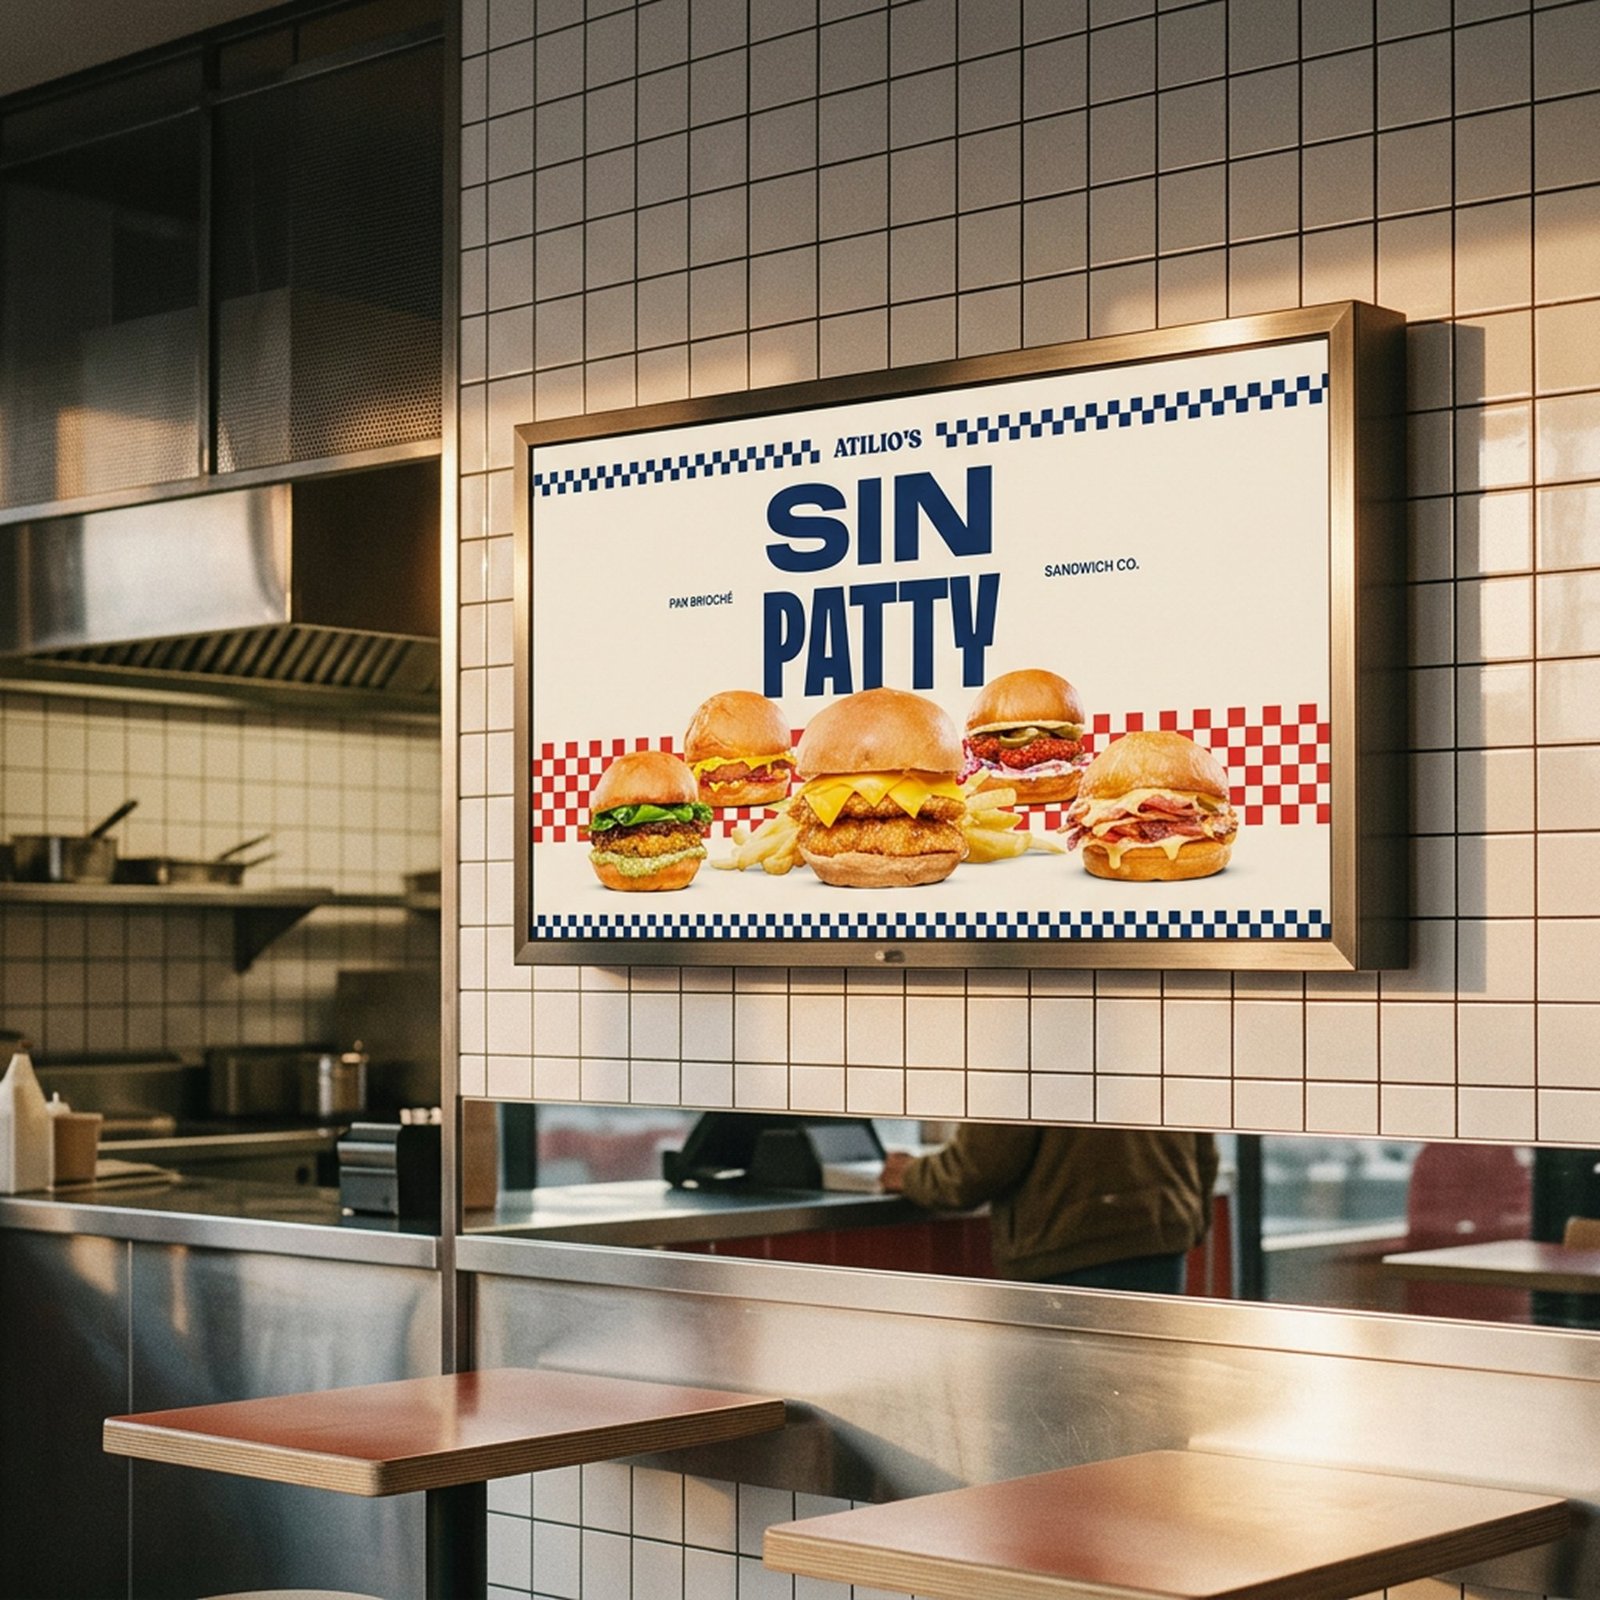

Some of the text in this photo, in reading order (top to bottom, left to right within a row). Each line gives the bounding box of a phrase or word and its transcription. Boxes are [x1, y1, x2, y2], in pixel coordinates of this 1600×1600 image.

[833, 429, 923, 458] ATILIO'S
[765, 465, 993, 573] SIN
[1044, 557, 1140, 578] SANDWICH CO.
[690, 590, 733, 607] BRIOCHÉ
[763, 572, 1001, 699] PATTY
